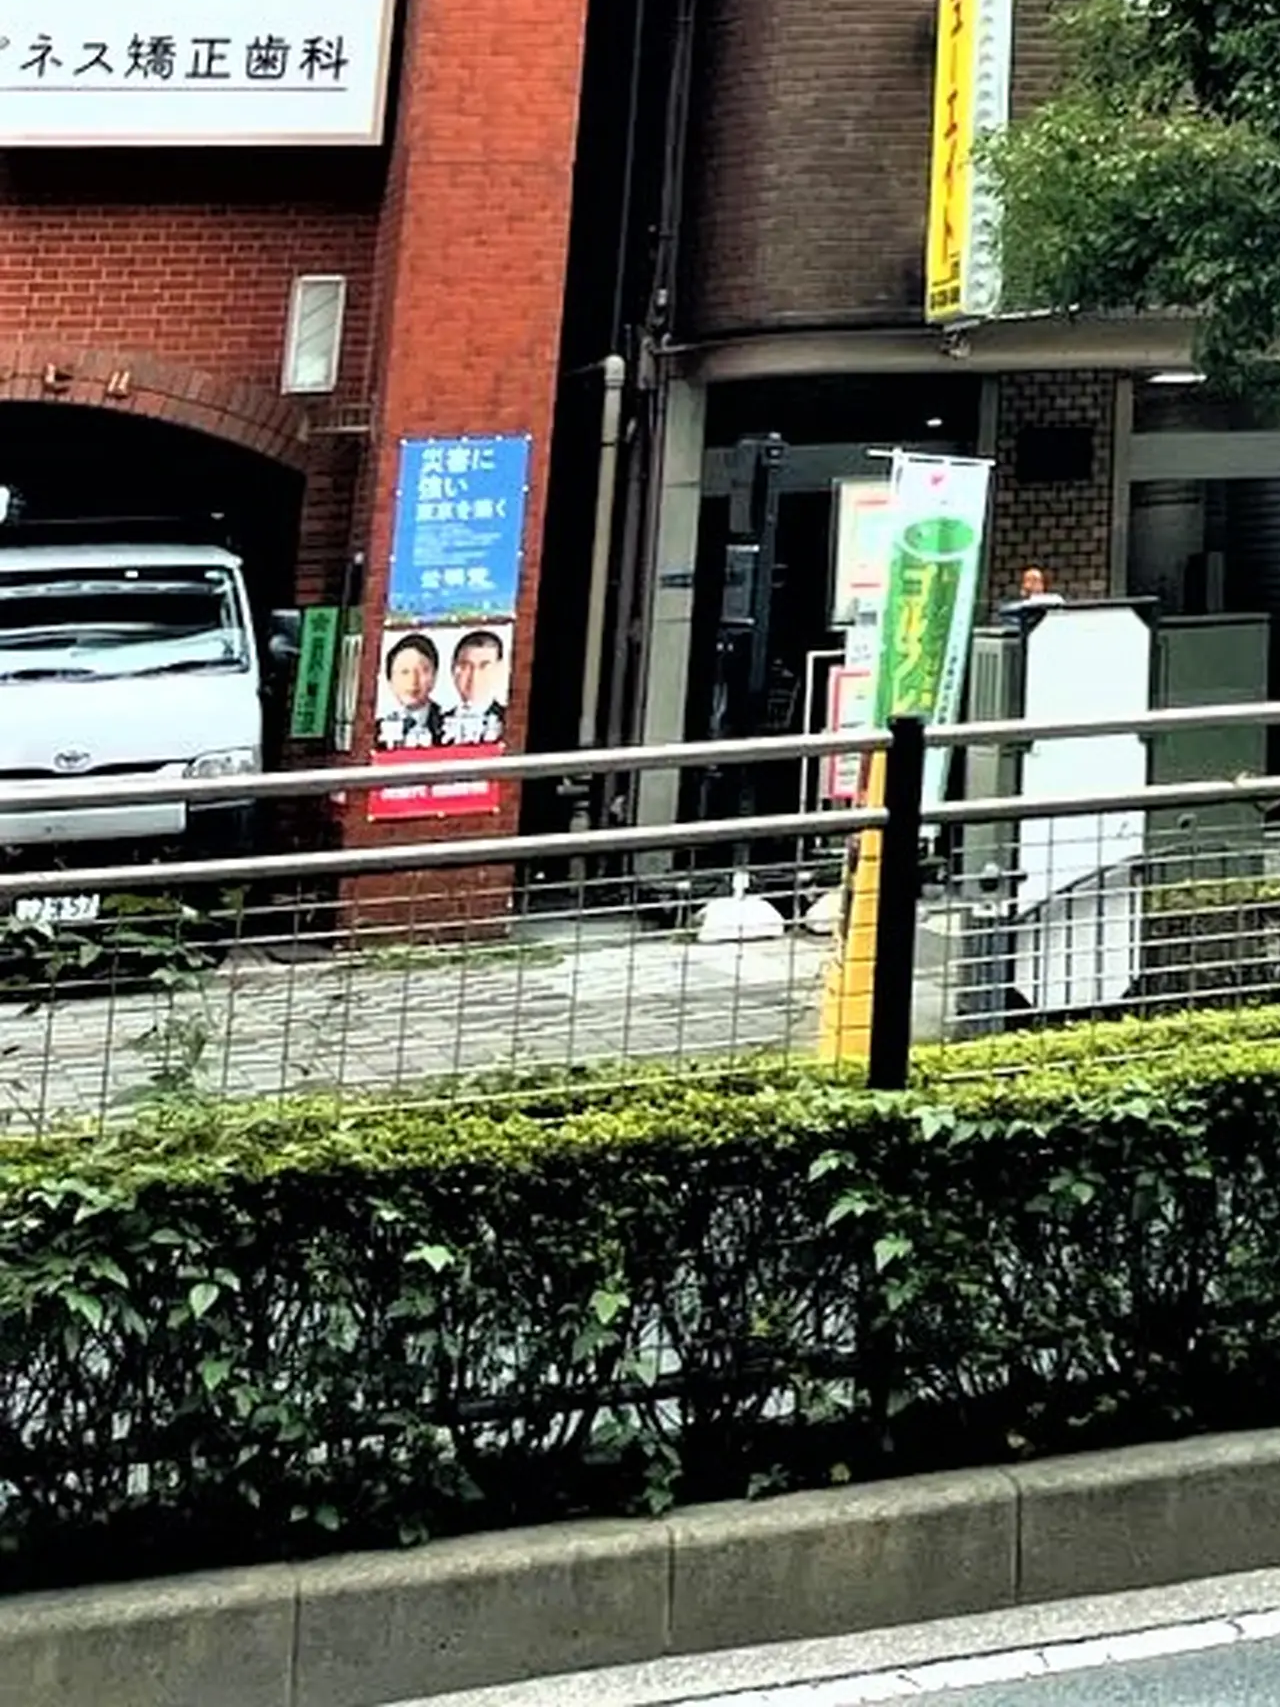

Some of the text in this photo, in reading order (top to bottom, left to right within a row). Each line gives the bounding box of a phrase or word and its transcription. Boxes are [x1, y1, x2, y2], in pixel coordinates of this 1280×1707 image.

[0, 34, 349, 81] ネス矯正歯科
